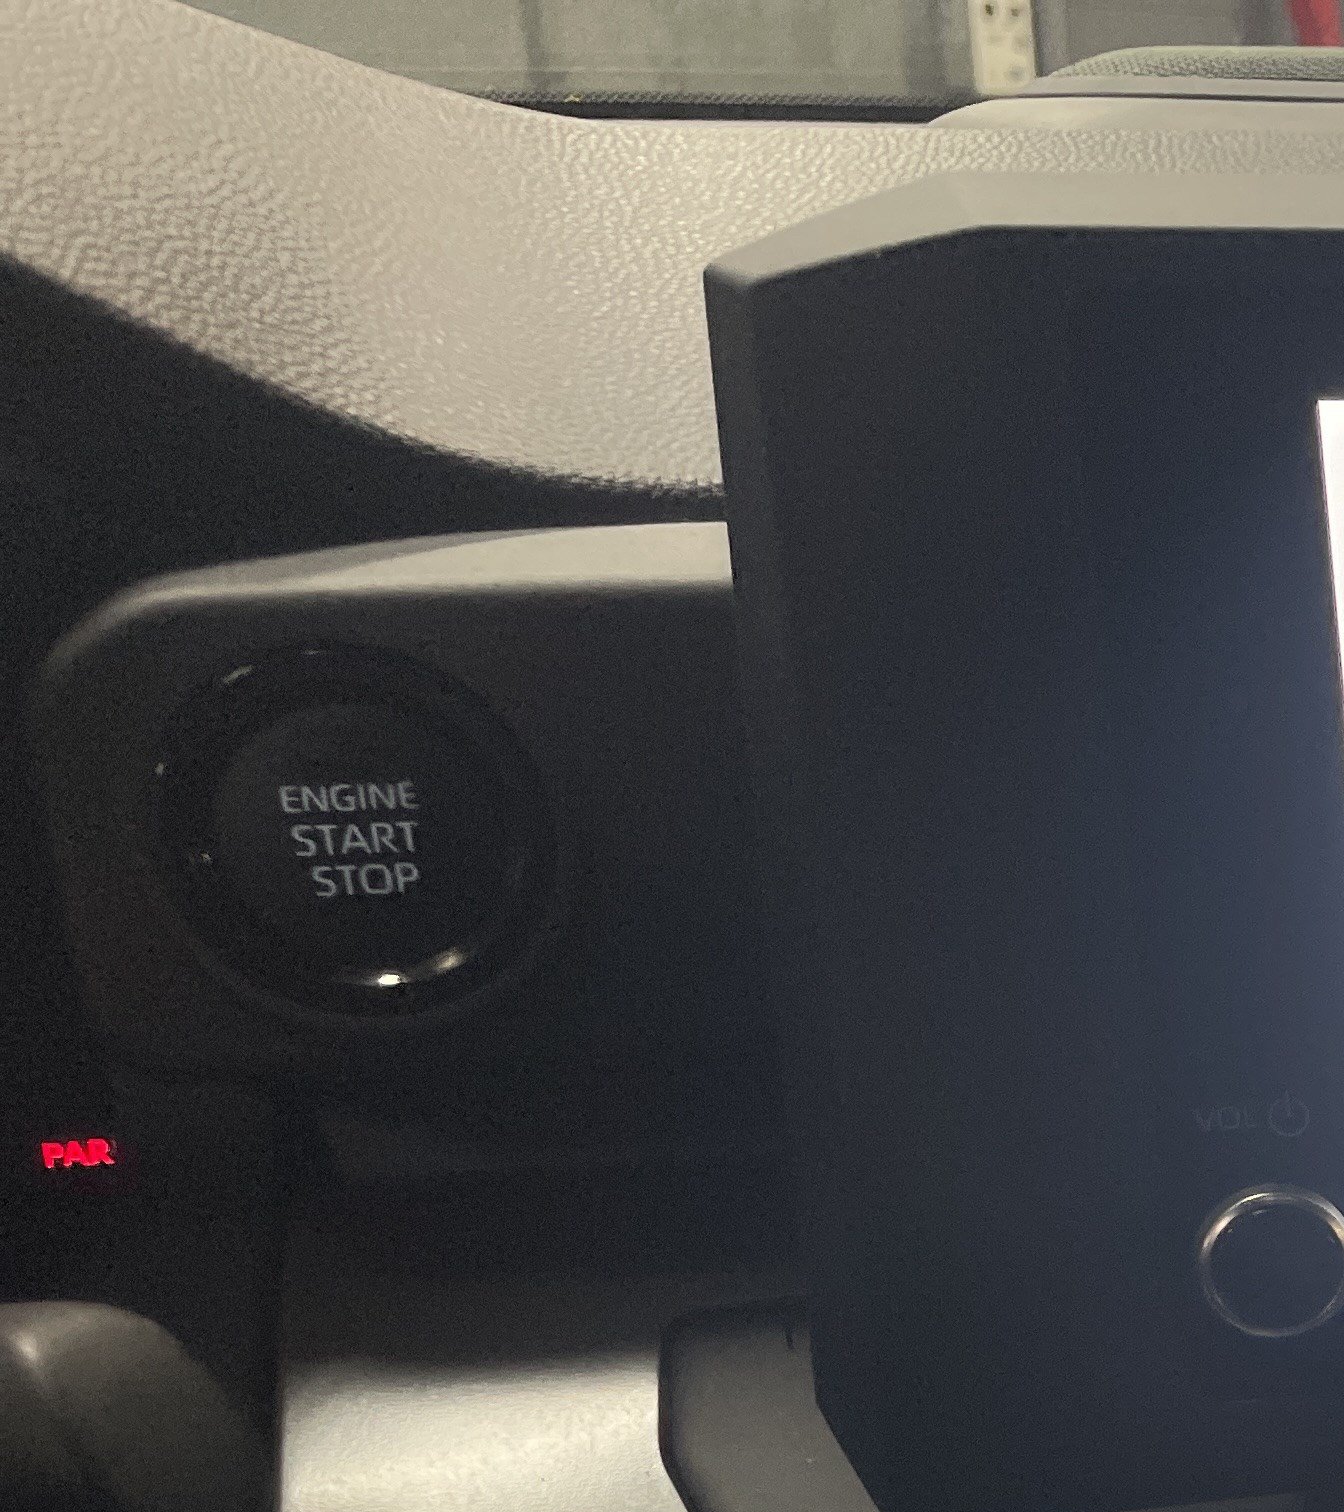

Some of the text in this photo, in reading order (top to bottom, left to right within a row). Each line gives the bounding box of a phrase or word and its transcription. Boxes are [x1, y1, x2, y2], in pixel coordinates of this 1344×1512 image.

[279, 780, 421, 813] ENGINE
[290, 820, 419, 857] START
[312, 862, 420, 898] STOP
[1191, 1106, 1258, 1132] VOL
